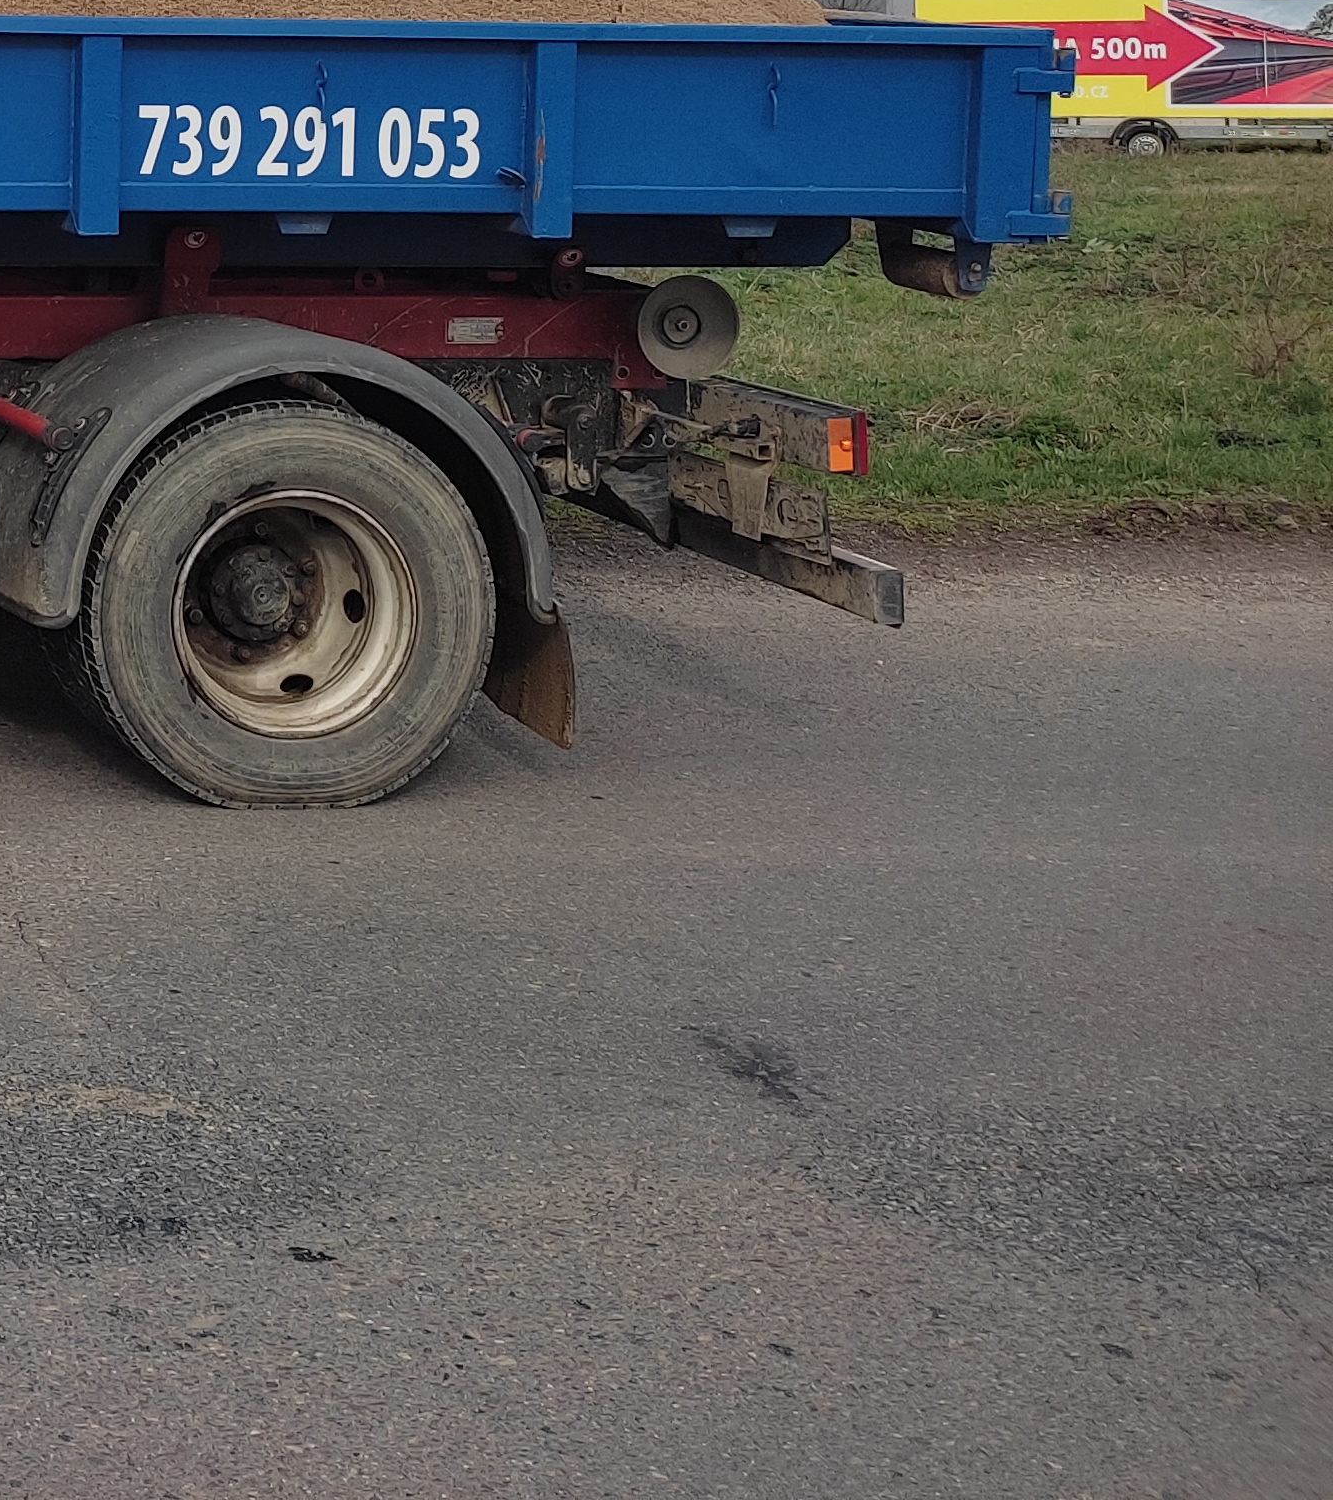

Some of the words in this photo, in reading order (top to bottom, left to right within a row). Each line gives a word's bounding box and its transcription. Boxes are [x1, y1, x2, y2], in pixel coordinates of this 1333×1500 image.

[1091, 37, 1167, 60] 500m
[138, 104, 242, 176] 739
[256, 105, 356, 178] 291
[378, 107, 480, 179] 053
